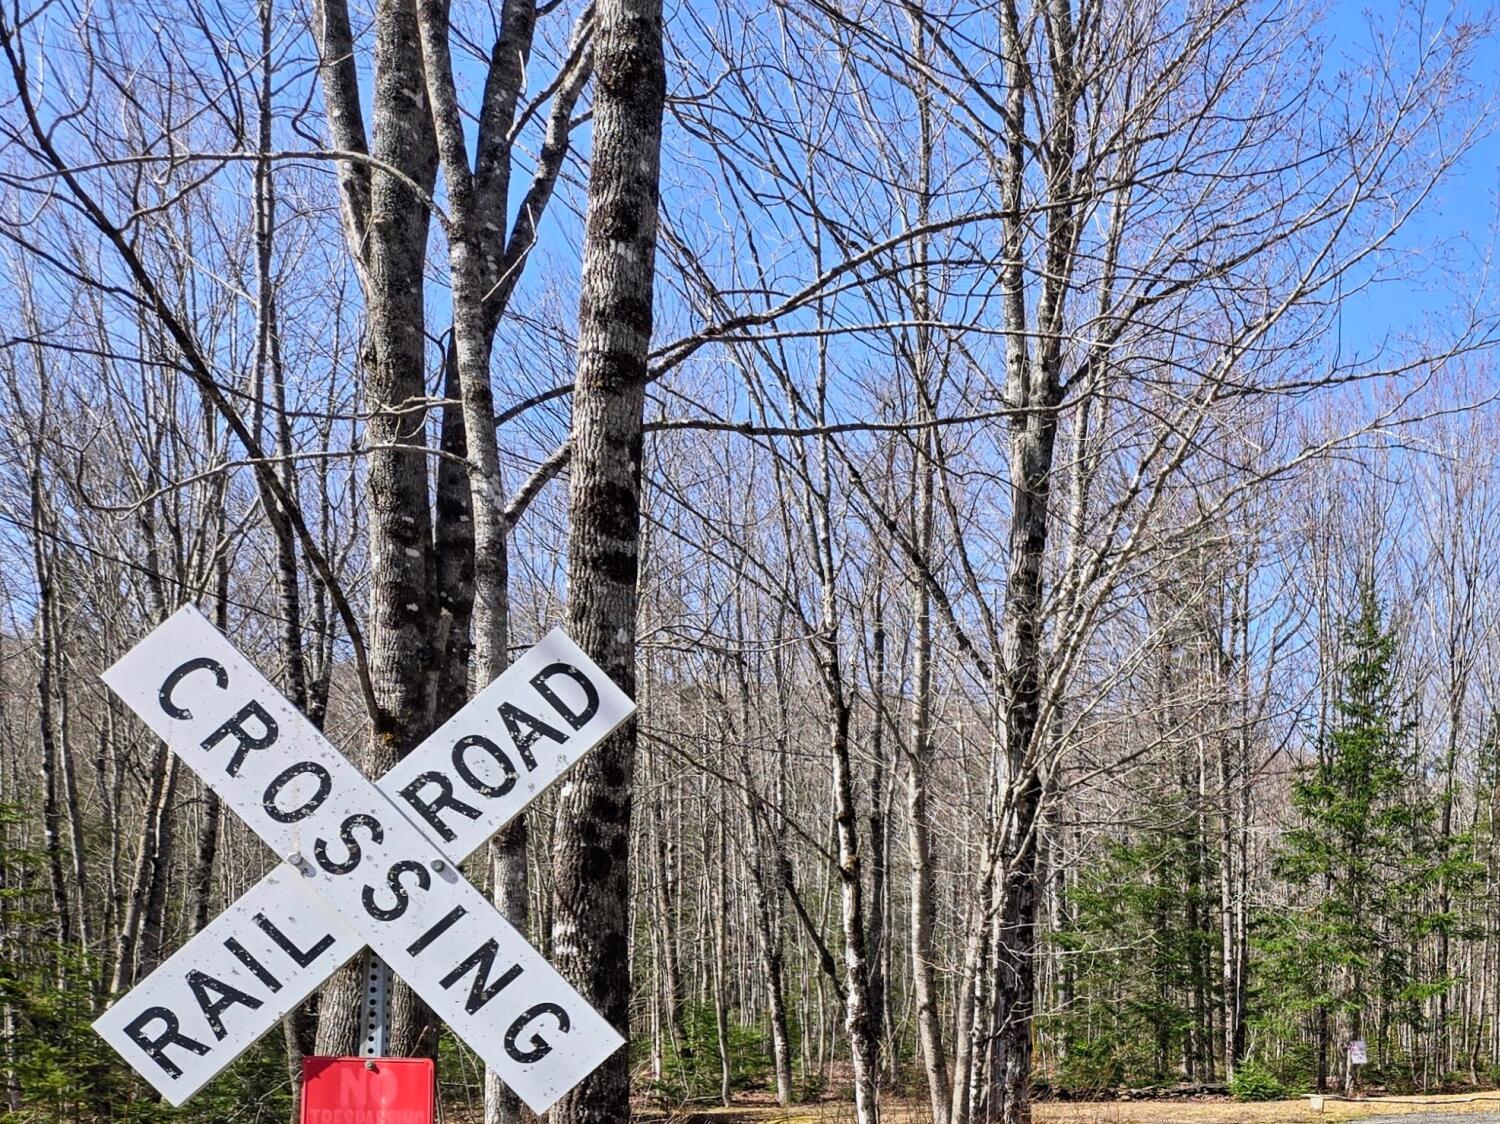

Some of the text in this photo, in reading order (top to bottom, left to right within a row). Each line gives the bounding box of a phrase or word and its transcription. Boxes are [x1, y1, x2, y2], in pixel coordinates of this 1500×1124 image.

[123, 661, 601, 1080] RAIL ROAD
[158, 656, 571, 1064] CROSSING
[340, 1067, 399, 1107] NO
